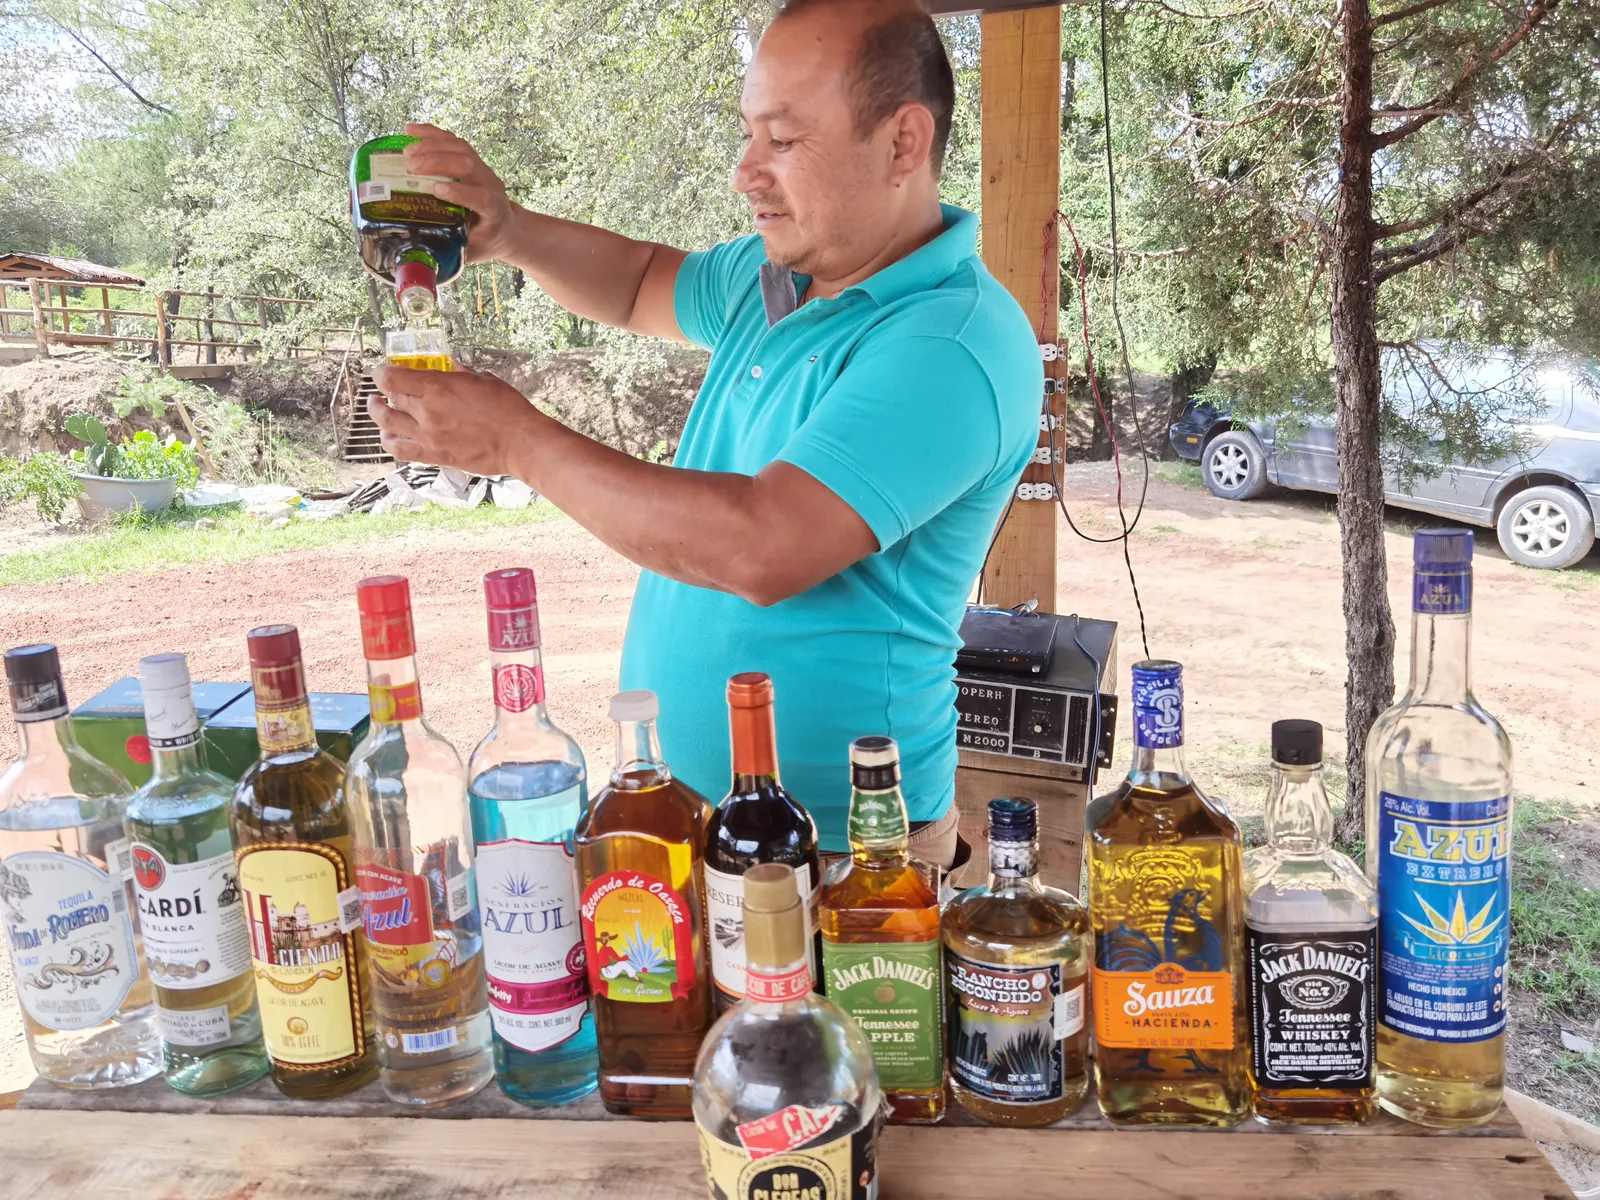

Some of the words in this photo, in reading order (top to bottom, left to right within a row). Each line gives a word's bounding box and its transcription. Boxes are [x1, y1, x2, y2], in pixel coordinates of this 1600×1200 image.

[1139, 723, 1172, 744] DESDE
[1033, 750, 1042, 759] B
[380, 873, 403, 884] AGAVE
[1406, 861, 1503, 880] EXTREMO
[58, 890, 94, 911] TEQUILA
[582, 876, 623, 922] Recuerdo
[627, 875, 645, 888] de
[649, 882, 684, 925] Oaxaca
[47, 904, 110, 944] ROMERO
[152, 924, 195, 933] BLANCA
[360, 898, 413, 943] Azul
[484, 905, 573, 935] AZUL
[494, 959, 516, 969] LICOR
[534, 958, 564, 969] AGAVE
[1259, 953, 1303, 983] JACK
[1302, 946, 1370, 982] DANIEL'S
[832, 962, 870, 991] JACK
[872, 956, 936, 991] DANIEL'S
[957, 966, 1031, 991] RANCHO
[634, 983, 663, 998] Gusano
[771, 981, 786, 996] DE
[951, 975, 1043, 1004] ESCONDIDO
[1408, 982, 1431, 994] HECHO
[1431, 985, 1441, 996] EN
[300, 996, 326, 1007] AGAVE
[1123, 981, 1215, 1016] Sauza
[1386, 988, 1394, 998] EL
[1394, 992, 1413, 1006] ABUSO
[1414, 997, 1424, 1009] EN
[1424, 999, 1432, 1010] EL
[1434, 1001, 1465, 1013] CONSUMO
[1466, 1001, 1474, 1011] DE
[1475, 1000, 1488, 1010] ESTE
[967, 998, 990, 1013] Licor
[990, 1004, 999, 1014] de
[1001, 1006, 1030, 1018] Agave
[1278, 1008, 1351, 1023] Tennessee
[1386, 998, 1415, 1017] PRODUCTO
[1415, 1008, 1423, 1018] ES
[1423, 1009, 1446, 1022] NOCIVO
[1471, 1009, 1488, 1021] SALUD
[198, 1017, 225, 1028] CUBA
[853, 1016, 920, 1030] Tennessee
[1132, 1018, 1211, 1028] HACIENDA
[868, 1032, 916, 1043] PPLE
[1281, 1030, 1350, 1041] WHISKEY
[1269, 1042, 1288, 1053] CONT.
[1289, 1042, 1303, 1053] NET.
[1324, 1042, 1337, 1052] 40%
[773, 1173, 799, 1190] DON
